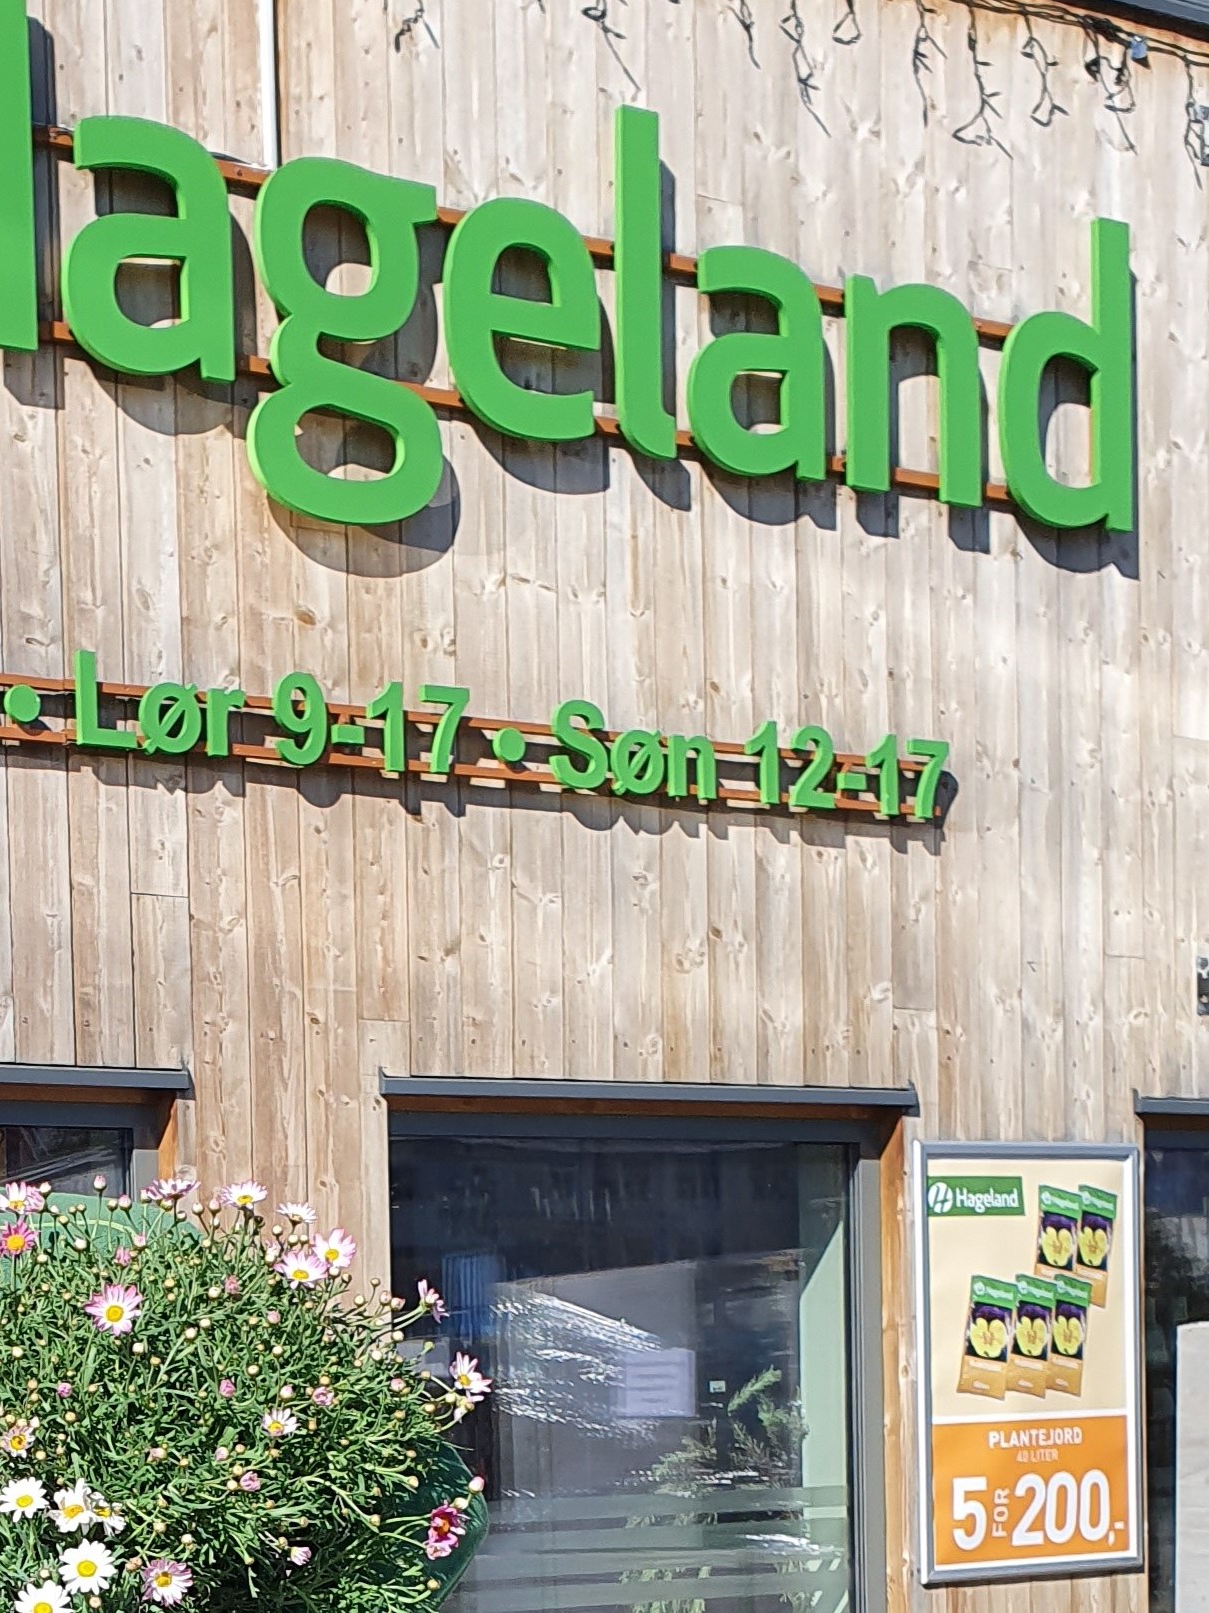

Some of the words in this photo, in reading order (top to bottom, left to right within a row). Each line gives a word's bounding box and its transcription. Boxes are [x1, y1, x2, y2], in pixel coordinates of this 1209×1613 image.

[73, 650, 247, 757] Lør
[273, 671, 471, 776] 9-17
[549, 699, 718, 803] Søn
[744, 718, 951, 823] 12-17
[955, 1186, 1020, 1213] Hageland
[988, 1426, 1083, 1449] PLANTEJORD
[1030, 1447, 1059, 1462] LITER
[952, 1475, 988, 1551] 5
[991, 1487, 1011, 1538] FOR
[1011, 1468, 1125, 1547] 200,-
